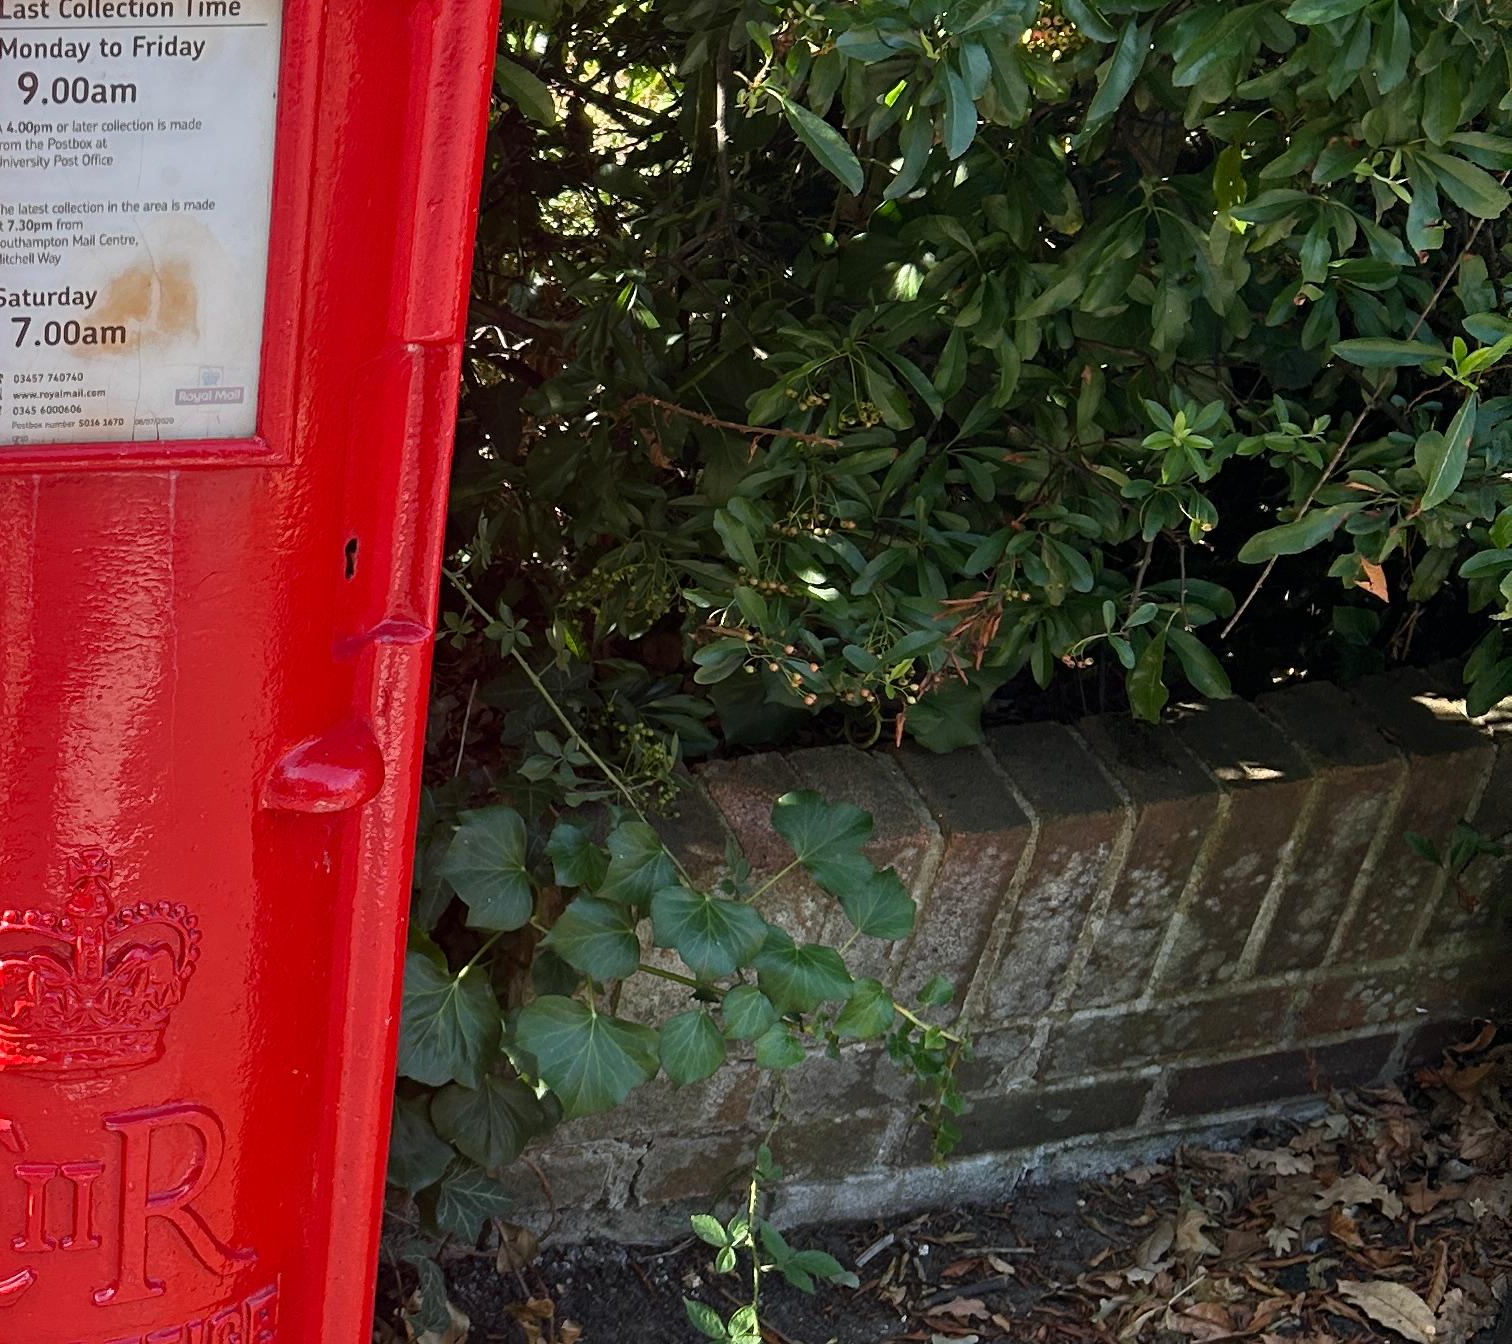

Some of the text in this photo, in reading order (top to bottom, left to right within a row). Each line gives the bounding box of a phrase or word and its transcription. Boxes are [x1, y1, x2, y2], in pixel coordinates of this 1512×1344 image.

[100, 38, 122, 58] to
[132, 35, 205, 61] Friday
[17, 71, 137, 105] 9.00am
[6, 121, 53, 136] 4.00pm
[56, 122, 69, 133] or
[72, 120, 97, 133] later
[101, 118, 154, 133] collection
[157, 118, 166, 131] is
[170, 117, 202, 131] made
[25, 138, 44, 150] the
[47, 137, 92, 150] Postbox
[95, 138, 108, 149] at
[53, 154, 78, 167] Post
[82, 153, 113, 166] Office
[18, 202, 49, 215] latest
[52, 201, 104, 214] collection
[107, 201, 118, 213] in
[121, 200, 139, 212] the
[143, 202, 168, 212] area
[172, 199, 180, 211] is
[184, 199, 216, 211] made
[7, 219, 53, 233] 7.30pm
[56, 218, 83, 231] from
[72, 234, 96, 247] Mail
[99, 233, 139, 247] Centre,
[37, 253, 61, 265] Way
[11, 317, 127, 348] 7.00am
[13, 373, 44, 384] 03457
[12, 389, 106, 401] www.royalmail.com
[178, 389, 241, 403] Royal Mail
[12, 405, 36, 416] 0345
